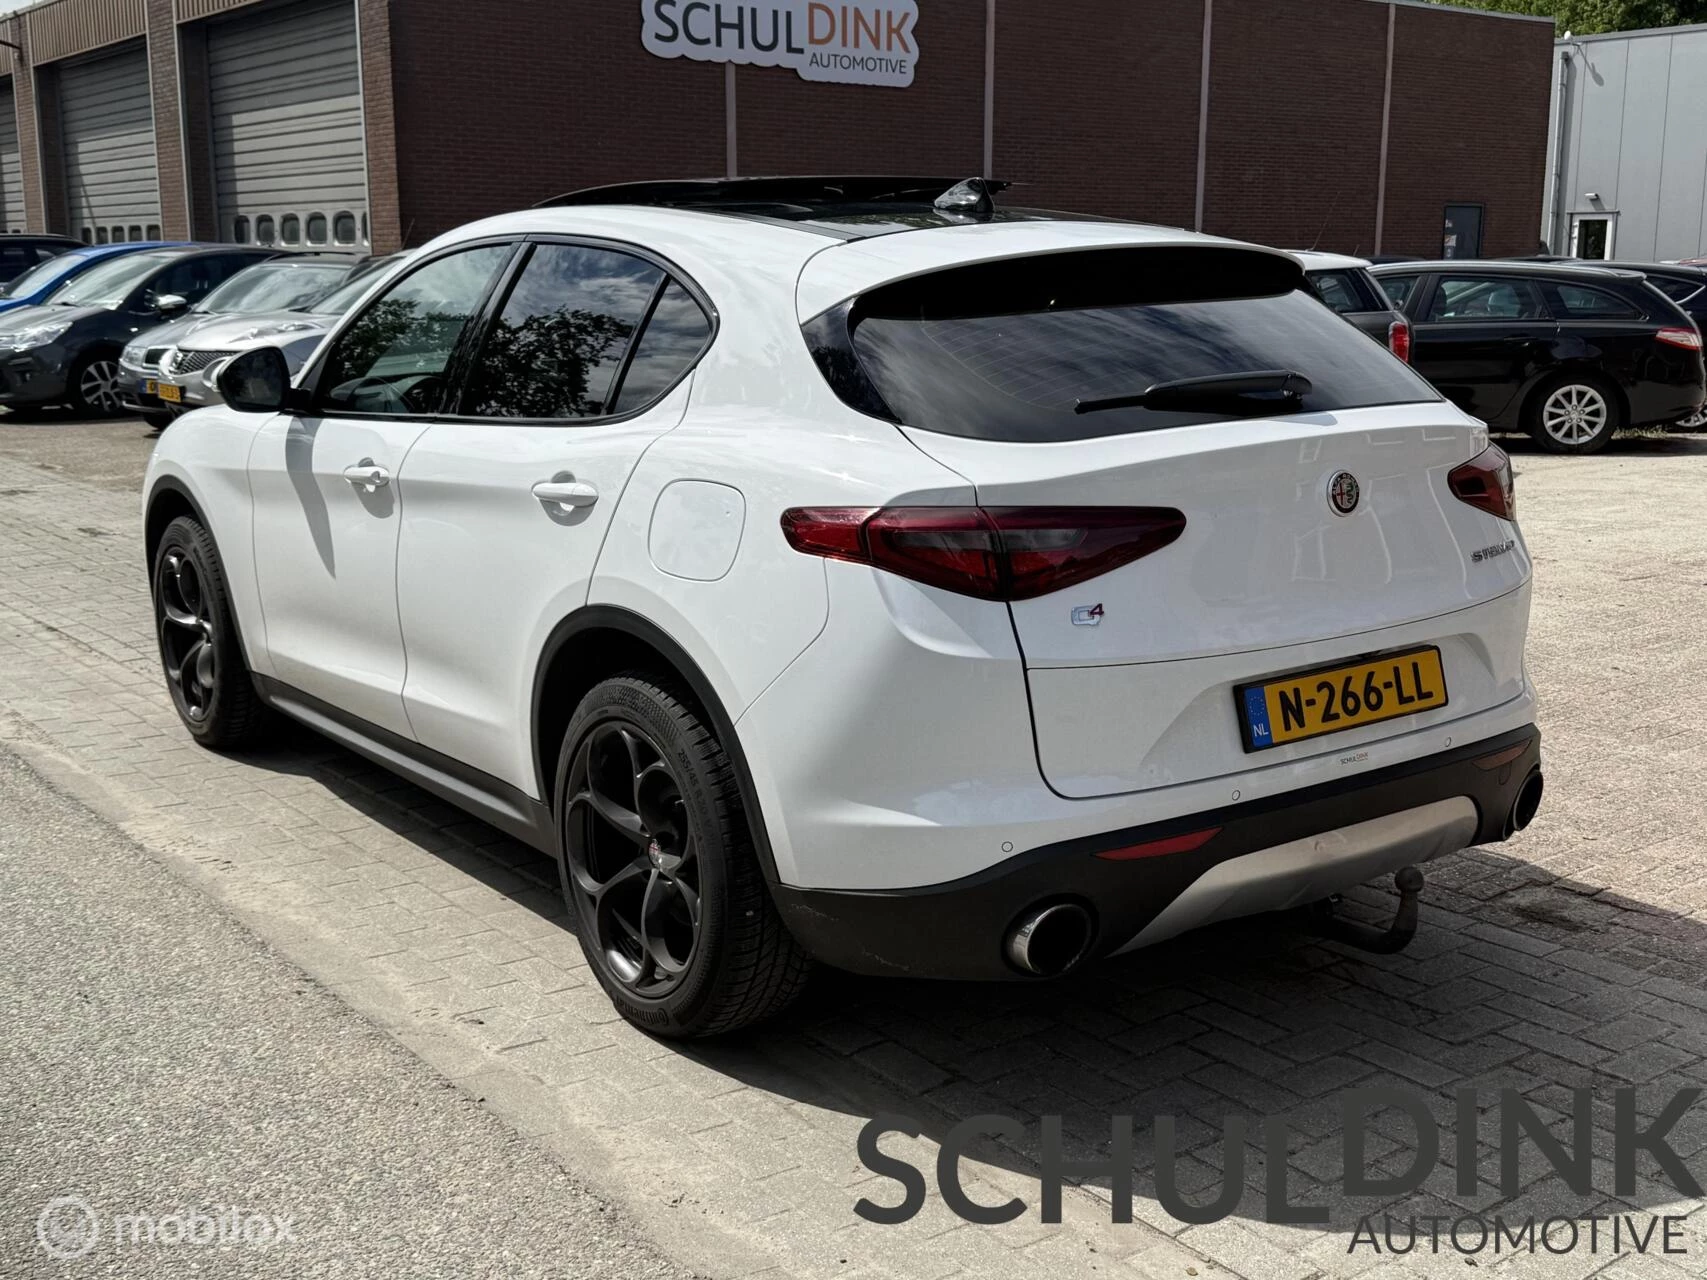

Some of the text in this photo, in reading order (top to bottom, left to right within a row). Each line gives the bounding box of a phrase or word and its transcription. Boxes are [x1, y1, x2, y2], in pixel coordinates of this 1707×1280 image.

[653, 0, 911, 54] SCHULDINK
[808, 52, 907, 75] AUTOMOTIVE
[1278, 661, 1434, 732] N-266-LL
[1253, 723, 1269, 738] NL
